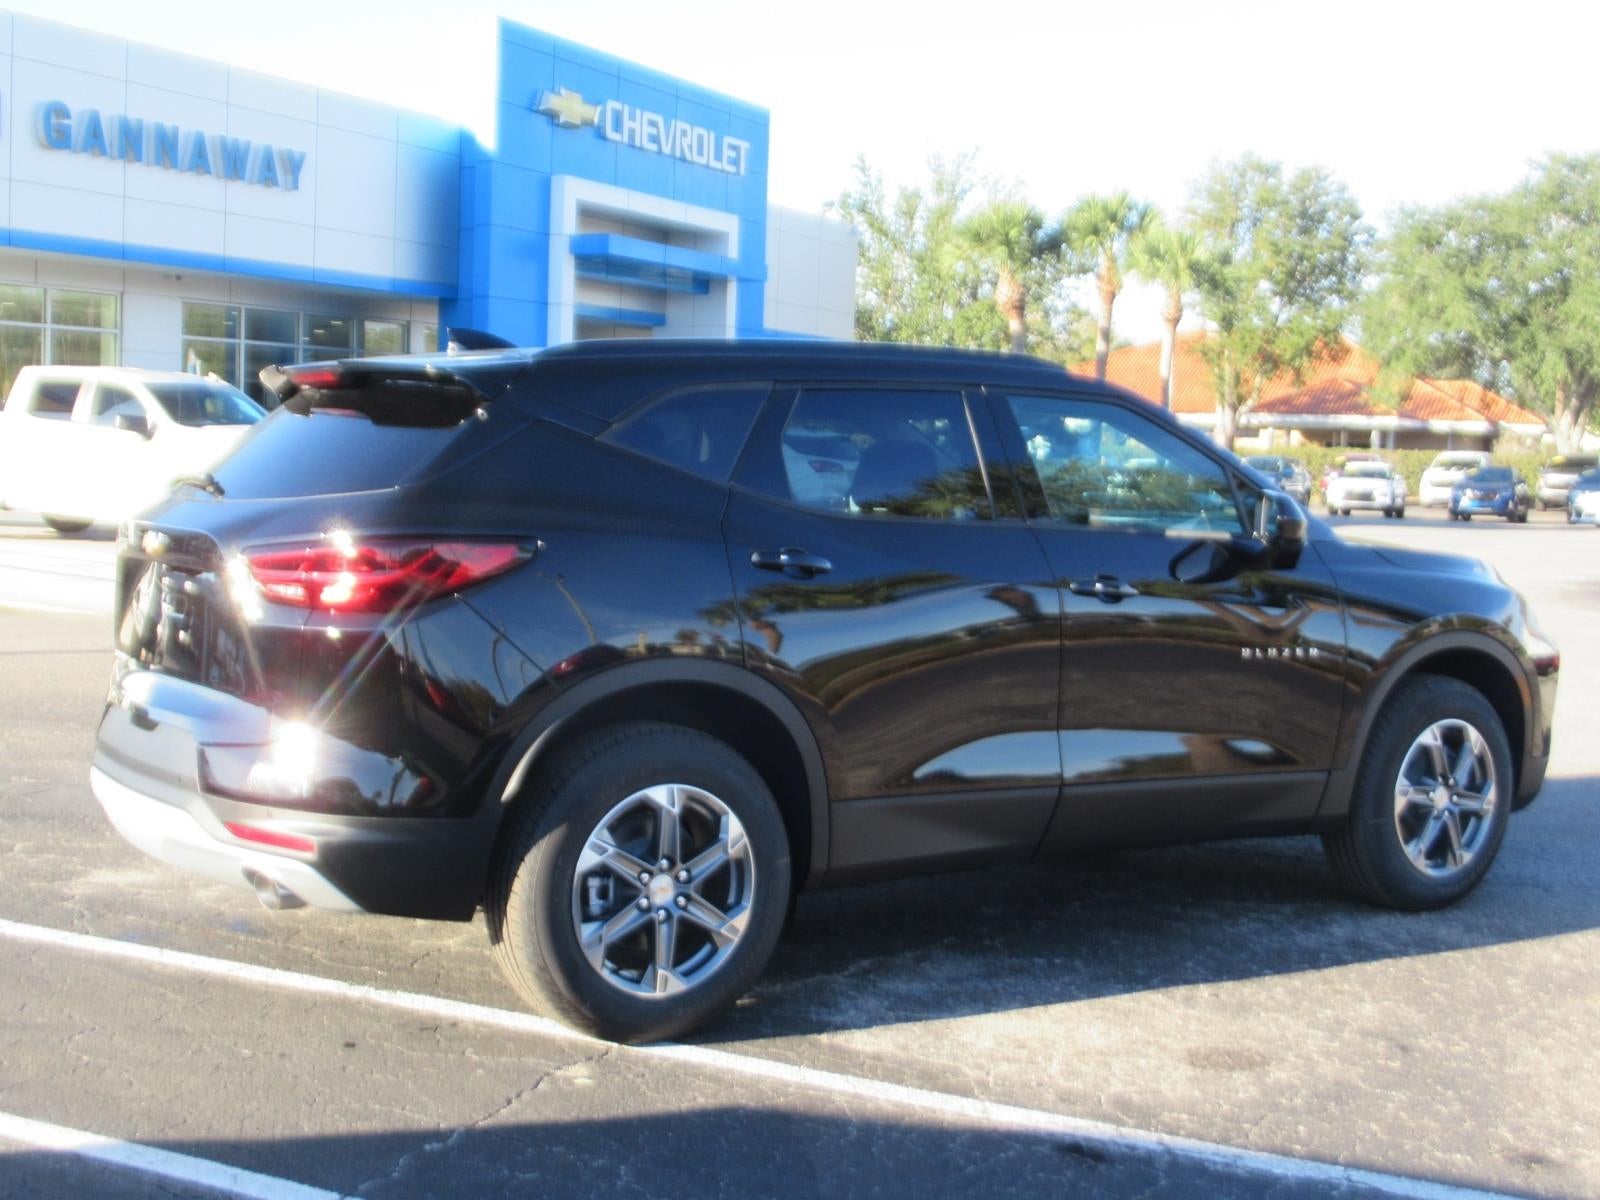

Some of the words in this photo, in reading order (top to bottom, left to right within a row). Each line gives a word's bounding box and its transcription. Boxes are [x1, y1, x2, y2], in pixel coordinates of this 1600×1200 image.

[36, 99, 306, 191] GANNAWAY
[604, 99, 751, 176] CHEVROLET
[1240, 646, 1320, 660] BLAZER
